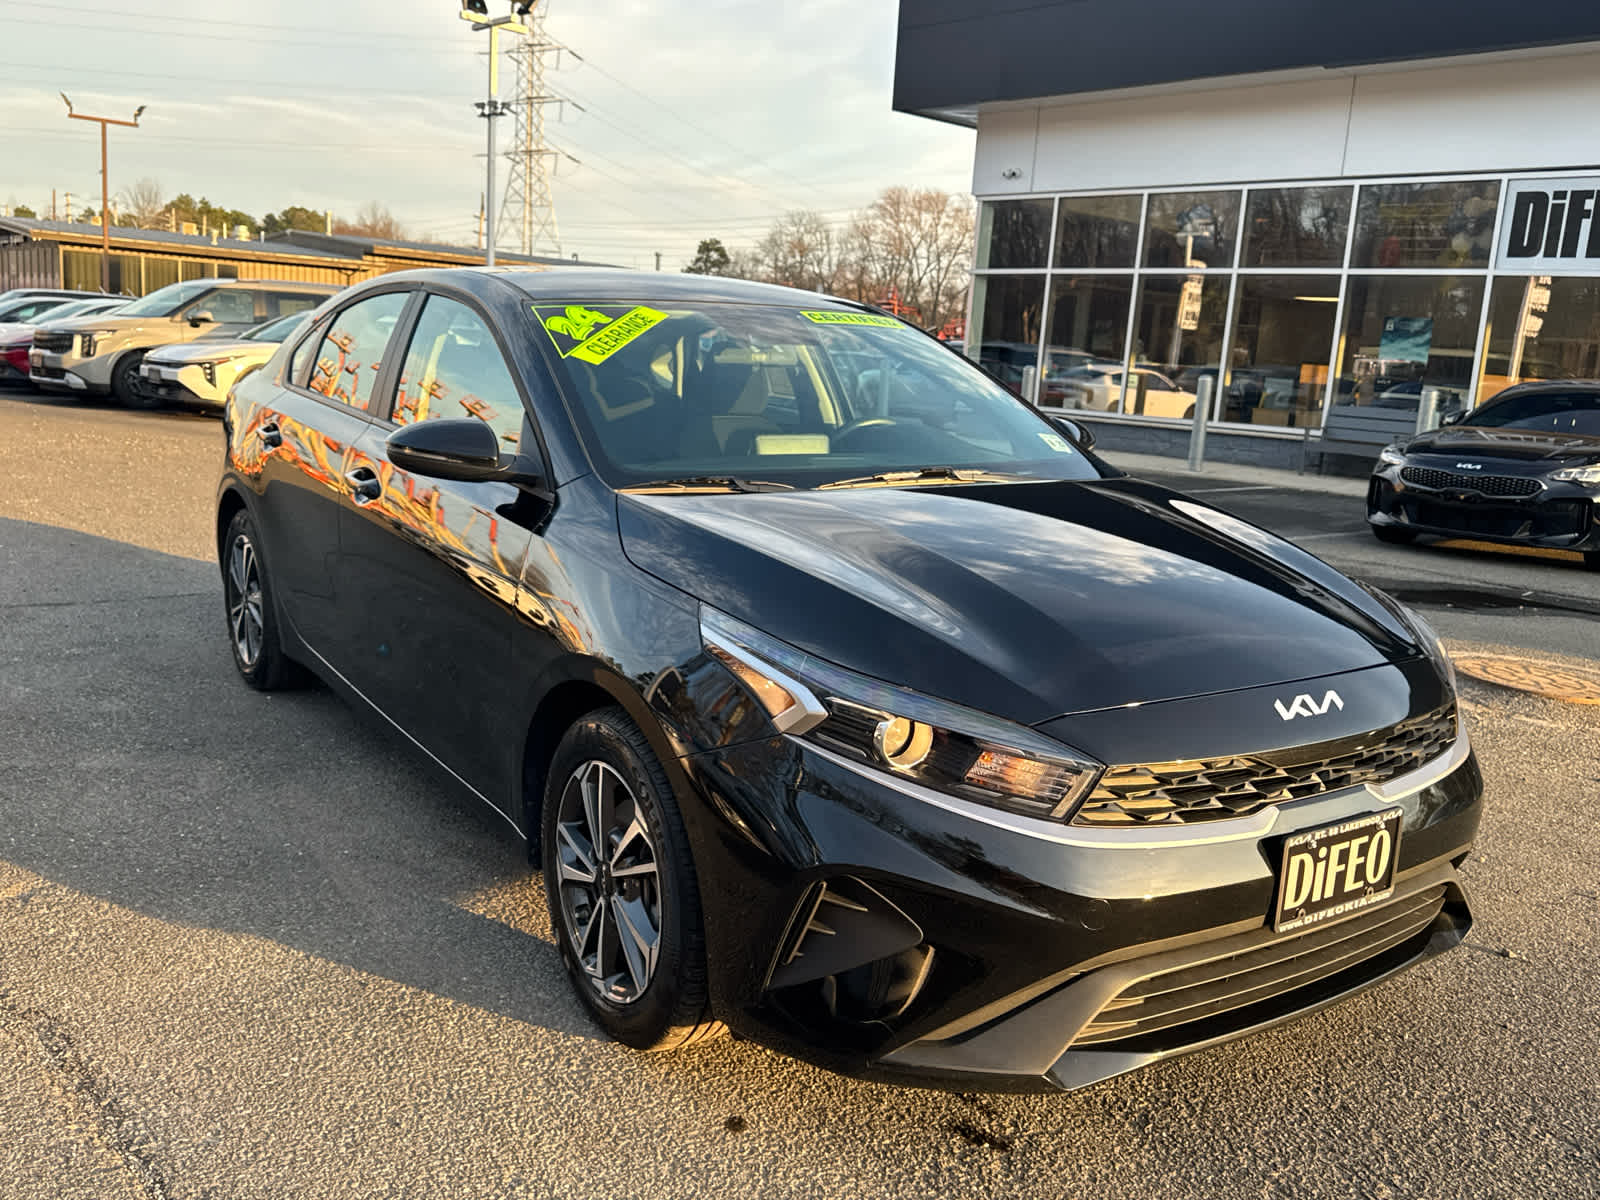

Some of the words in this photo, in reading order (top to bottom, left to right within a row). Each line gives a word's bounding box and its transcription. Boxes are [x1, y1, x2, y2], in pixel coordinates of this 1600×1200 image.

[545, 306, 613, 341] 24
[586, 313, 654, 356] CLEARANCE
[1274, 689, 1344, 720] KIA
[1283, 829, 1391, 911] DiFEO
